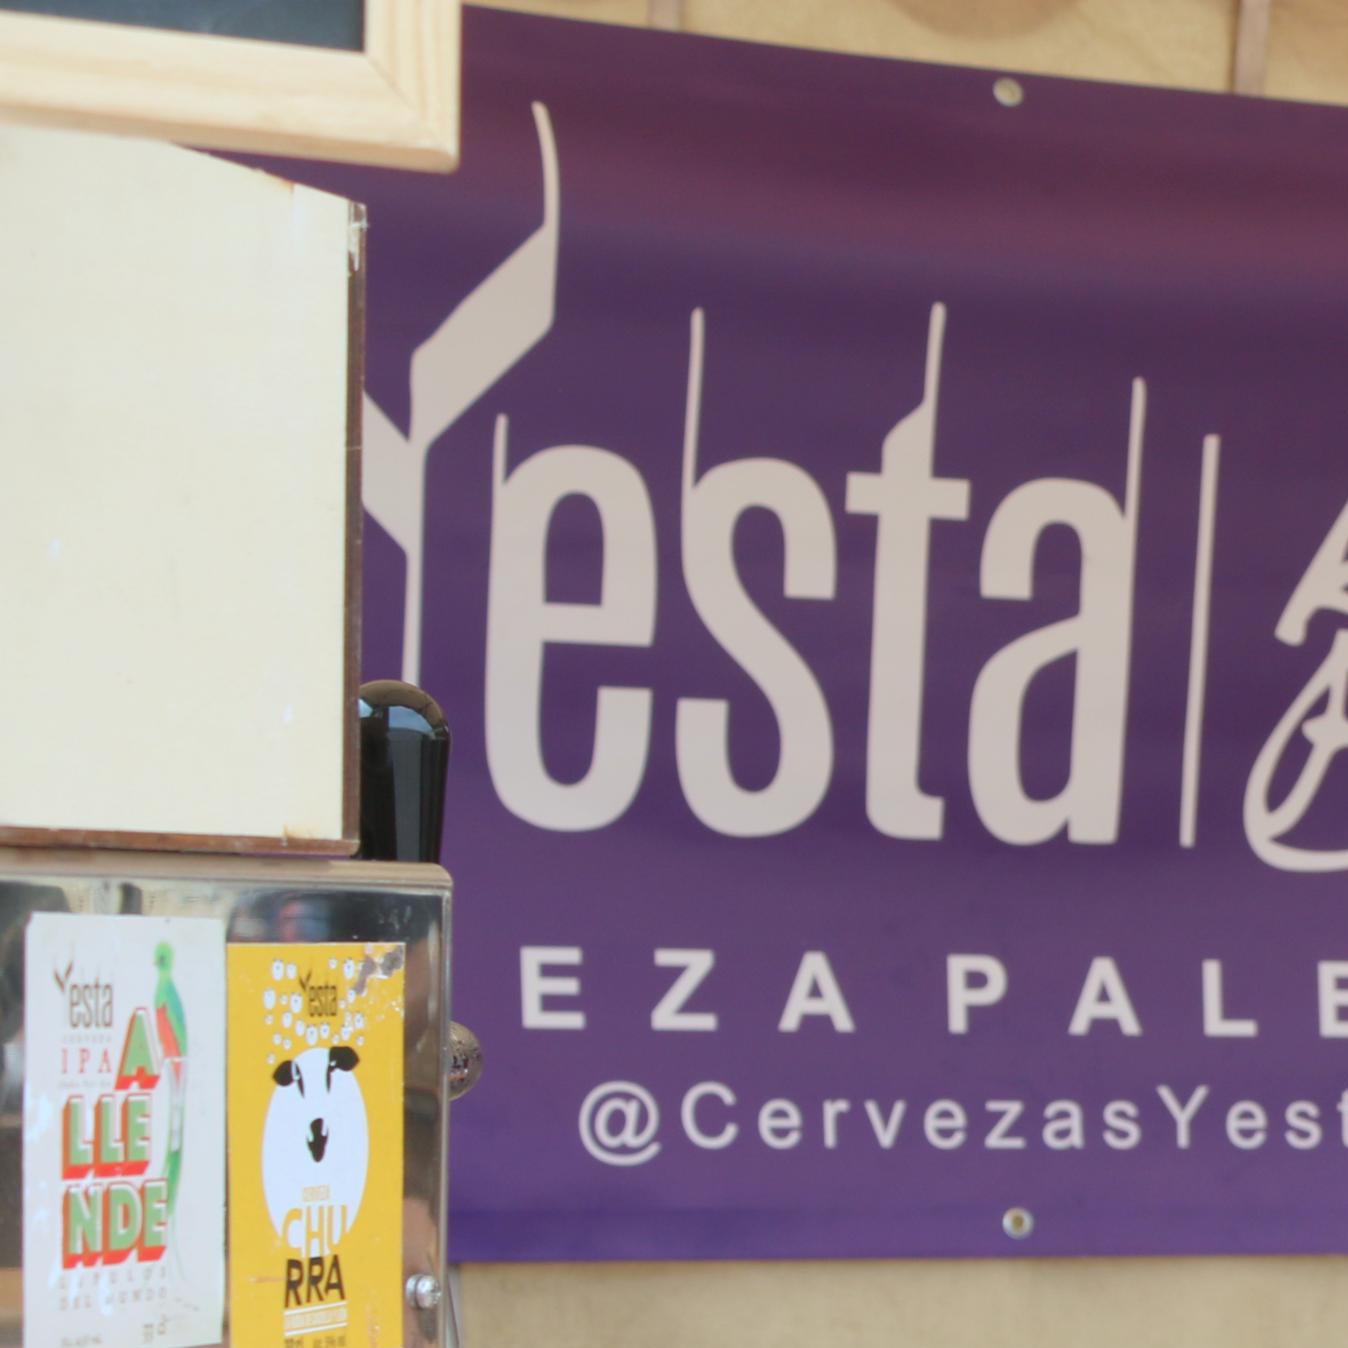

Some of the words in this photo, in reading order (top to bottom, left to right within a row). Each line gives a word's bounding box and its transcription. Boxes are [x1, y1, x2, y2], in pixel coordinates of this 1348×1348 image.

[53, 960, 113, 1028] Yesta
[299, 968, 337, 1017] Yesta
[520, 946, 855, 1033] EZA
[61, 1048, 112, 1075] IPA
[62, 1094, 152, 1180] LLE
[62, 1179, 168, 1269] NDE
[284, 1254, 345, 1308] RRA
